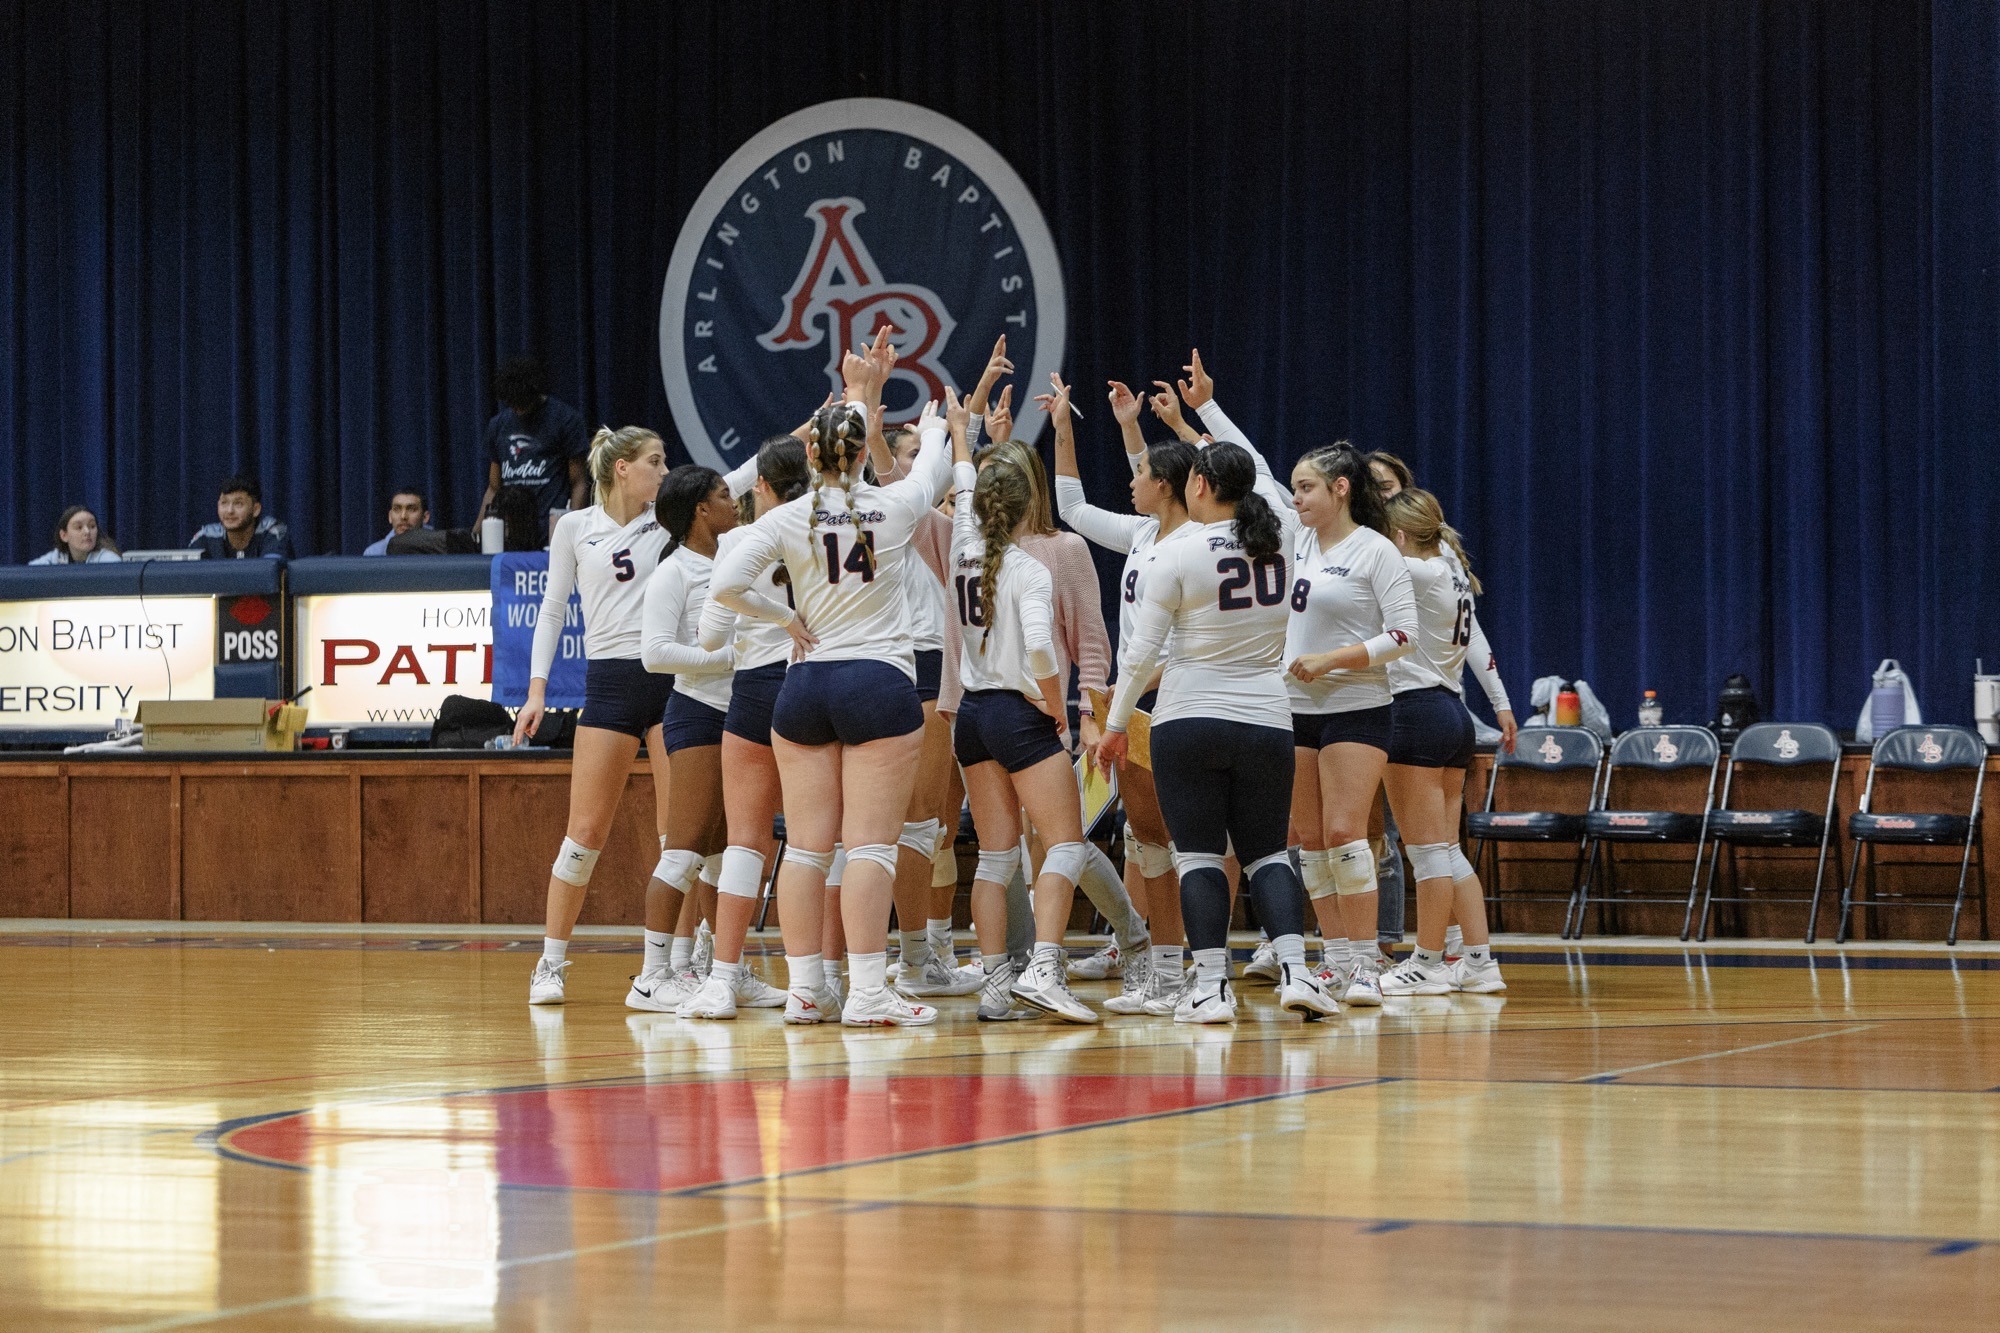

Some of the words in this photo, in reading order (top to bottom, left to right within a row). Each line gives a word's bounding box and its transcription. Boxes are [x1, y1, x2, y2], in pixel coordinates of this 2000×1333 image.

[695, 140, 845, 373] ARLINGTON
[904, 147, 1026, 328] BAPTIST
[814, 509, 886, 527] Patrots
[822, 530, 877, 585] 14
[1207, 536, 1245, 552] Pat
[612, 548, 636, 583] 5
[1216, 552, 1287, 611] 20
[1124, 569, 1139, 604] 9
[1291, 577, 1312, 613] 8
[422, 607, 492, 628] HOM
[1452, 598, 1472, 647] 13
[224, 630, 278, 661] POSS
[321, 639, 492, 686] PAT
[0, 685, 133, 712] ERSITY
